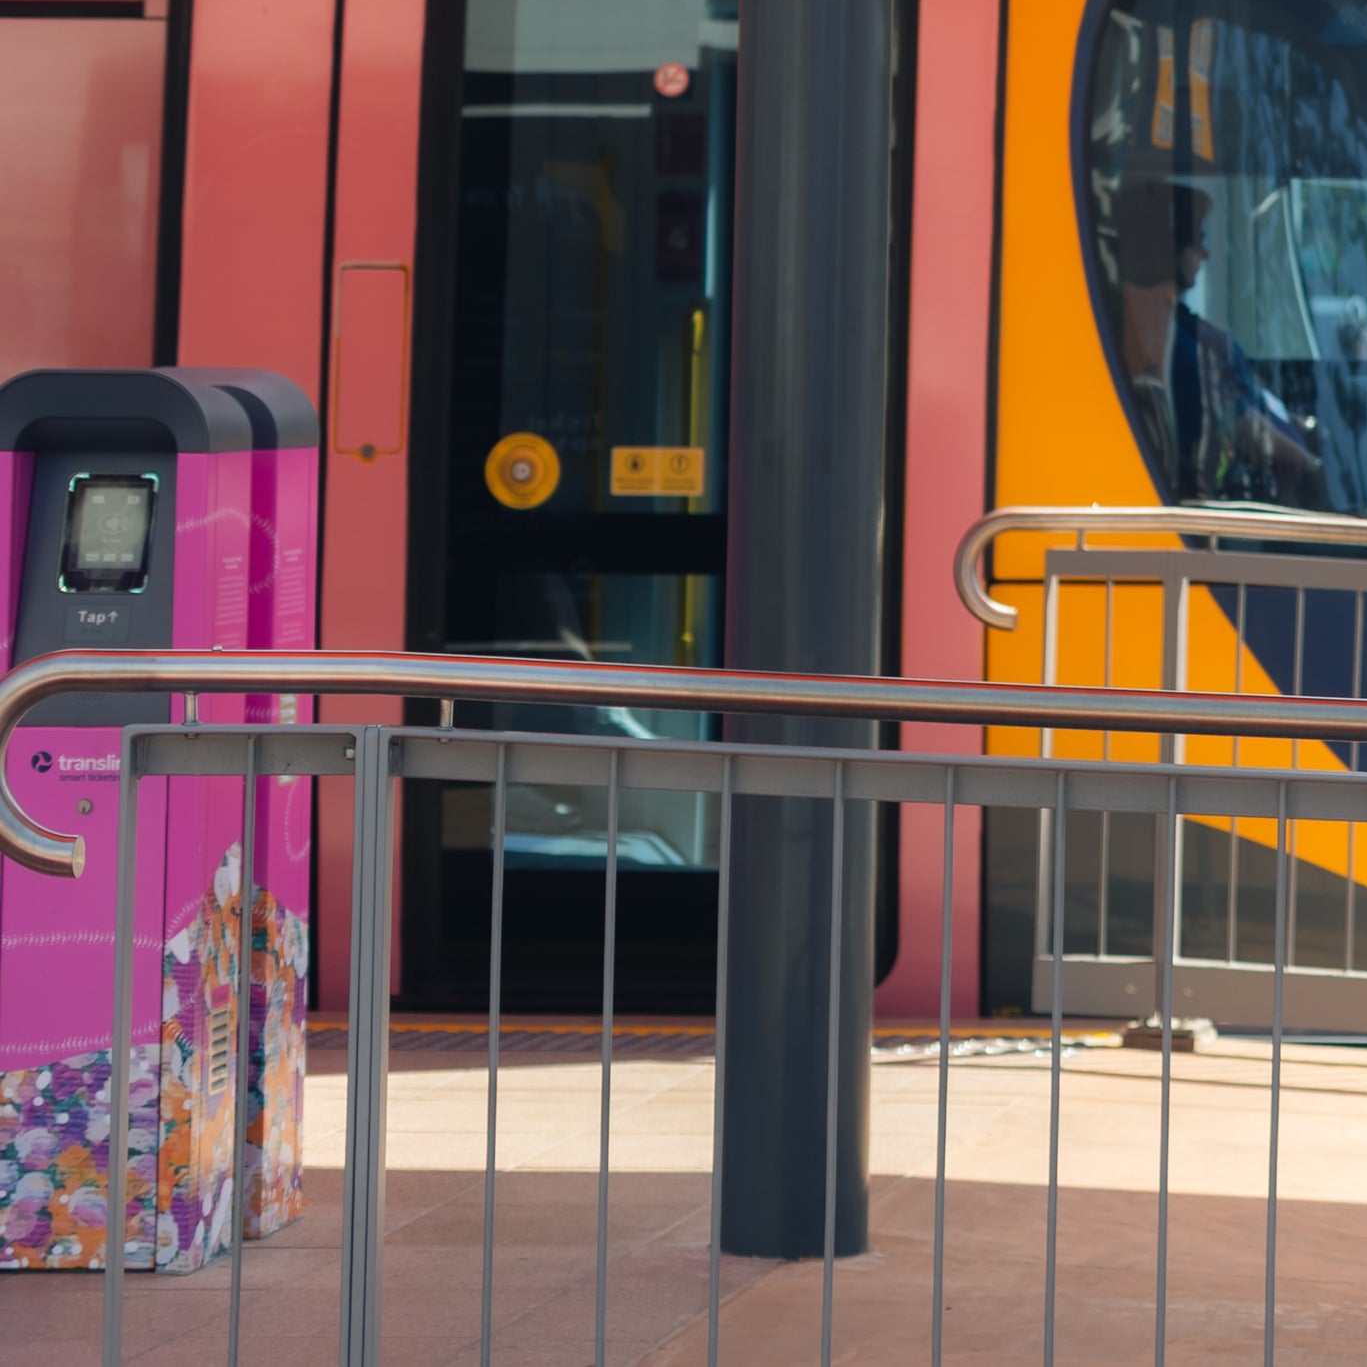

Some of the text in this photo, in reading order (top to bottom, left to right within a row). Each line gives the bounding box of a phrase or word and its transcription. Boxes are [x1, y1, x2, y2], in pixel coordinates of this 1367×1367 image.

[78, 610, 106, 625] Tap
[58, 754, 121, 771] transli
[59, 773, 120, 782] smart ticketin
